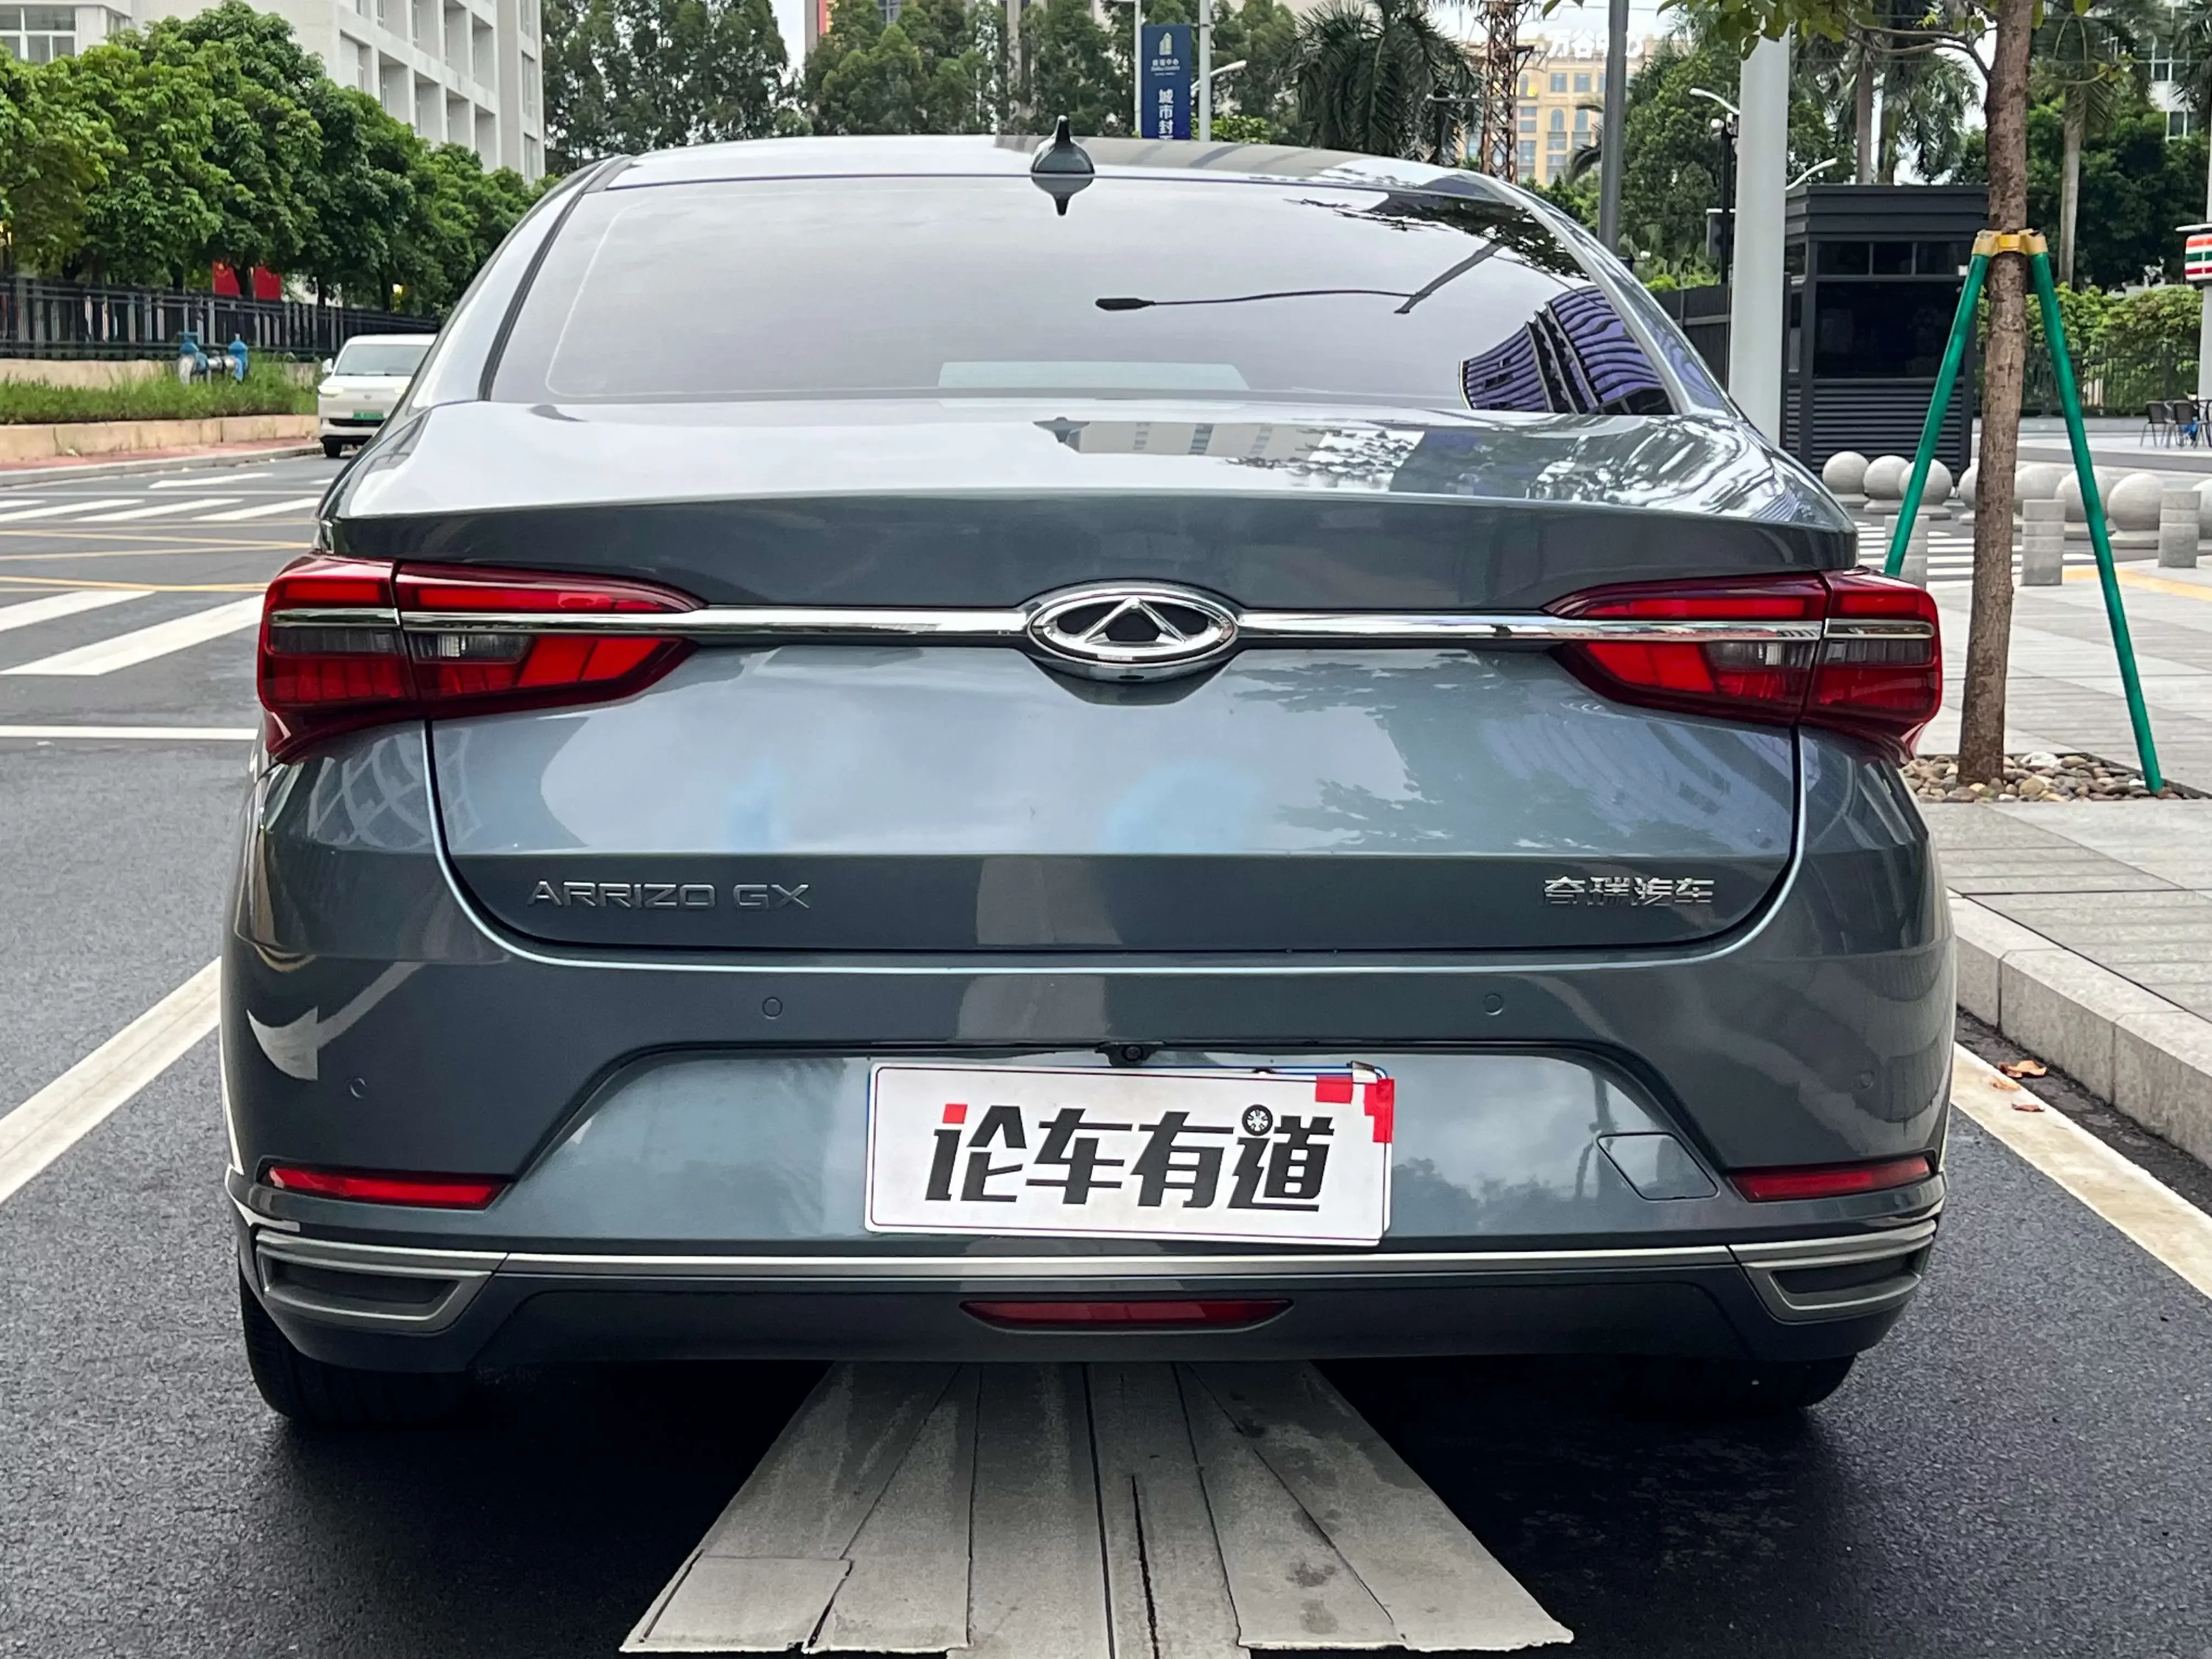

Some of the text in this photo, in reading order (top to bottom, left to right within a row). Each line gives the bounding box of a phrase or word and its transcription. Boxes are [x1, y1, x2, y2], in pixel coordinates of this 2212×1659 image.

[1158, 88, 1173, 139] 城市封
[527, 880, 810, 909] ARRIZO GX
[1543, 876, 1715, 906] 奇瑞汽车
[925, 1103, 1335, 1212] 论车有道
